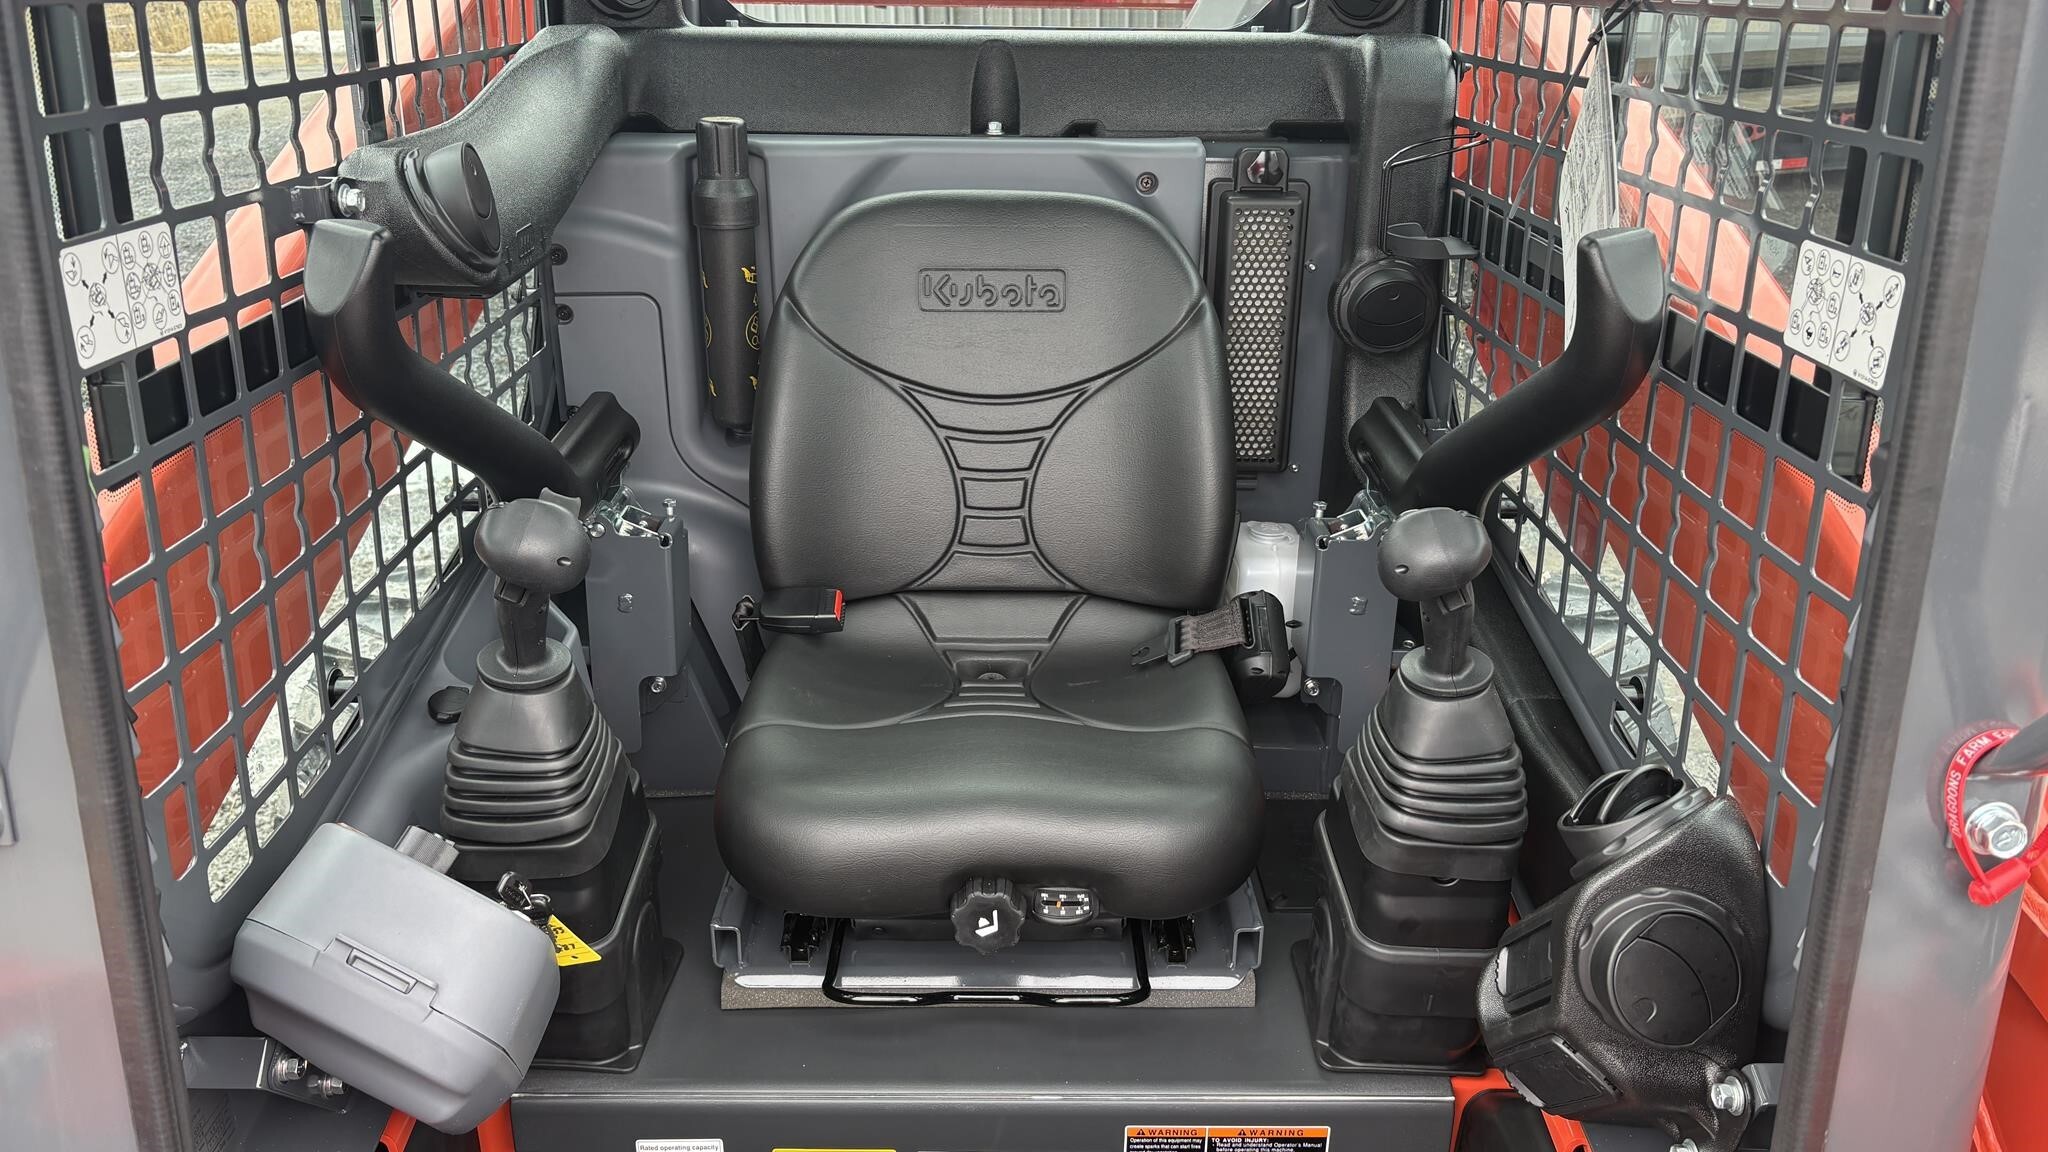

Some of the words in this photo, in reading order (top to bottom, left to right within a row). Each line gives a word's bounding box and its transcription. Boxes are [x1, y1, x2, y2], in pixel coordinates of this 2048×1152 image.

[923, 274, 1061, 307] Kubota
[1947, 771, 1962, 837] DRAGOONS
[1955, 736, 1991, 766] FARM
[659, 1144, 691, 1152] operating
[692, 1144, 719, 1152] capacity
